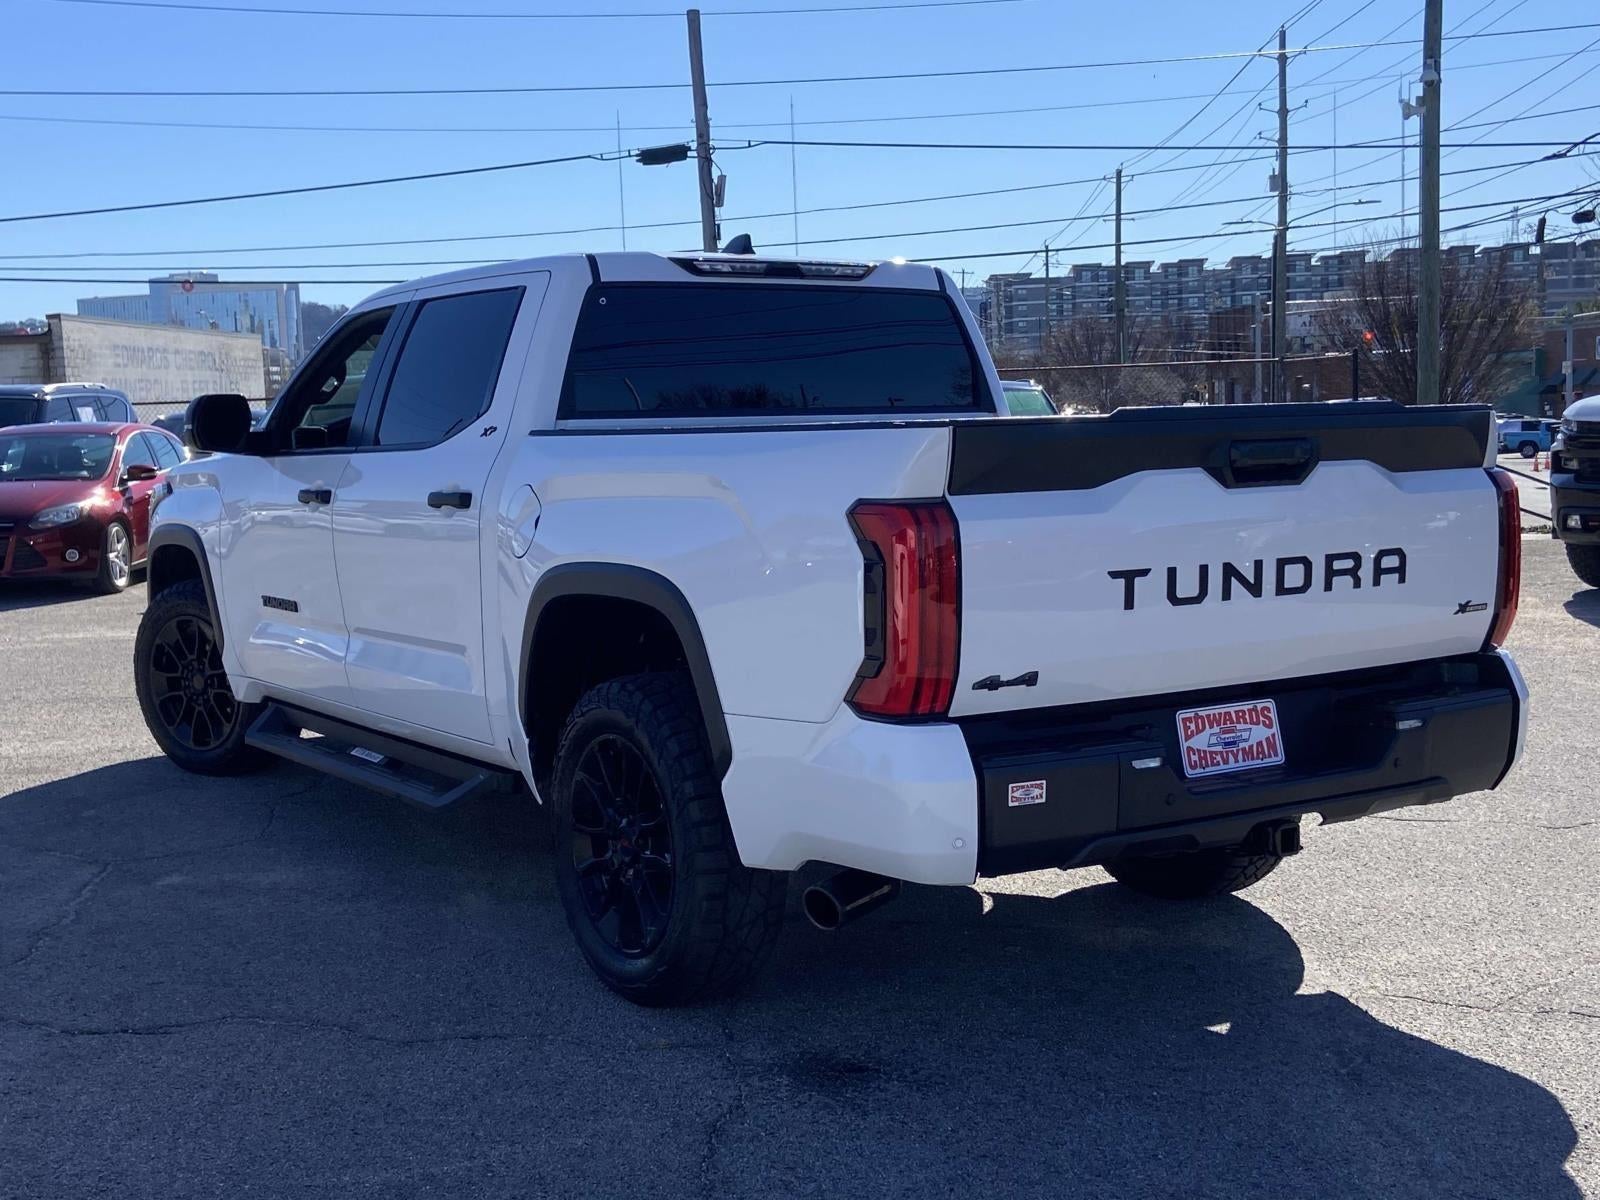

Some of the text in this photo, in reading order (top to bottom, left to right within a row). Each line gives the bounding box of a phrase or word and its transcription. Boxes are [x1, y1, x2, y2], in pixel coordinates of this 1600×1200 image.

[1107, 547, 1406, 610] TUNDRA
[261, 594, 299, 613] TUNDRA
[1181, 705, 1274, 742] EDWARDS
[1186, 732, 1279, 771] CHEVYMAN
[1215, 733, 1243, 743] Chevrolet
[1011, 782, 1044, 793] EDWARDS
